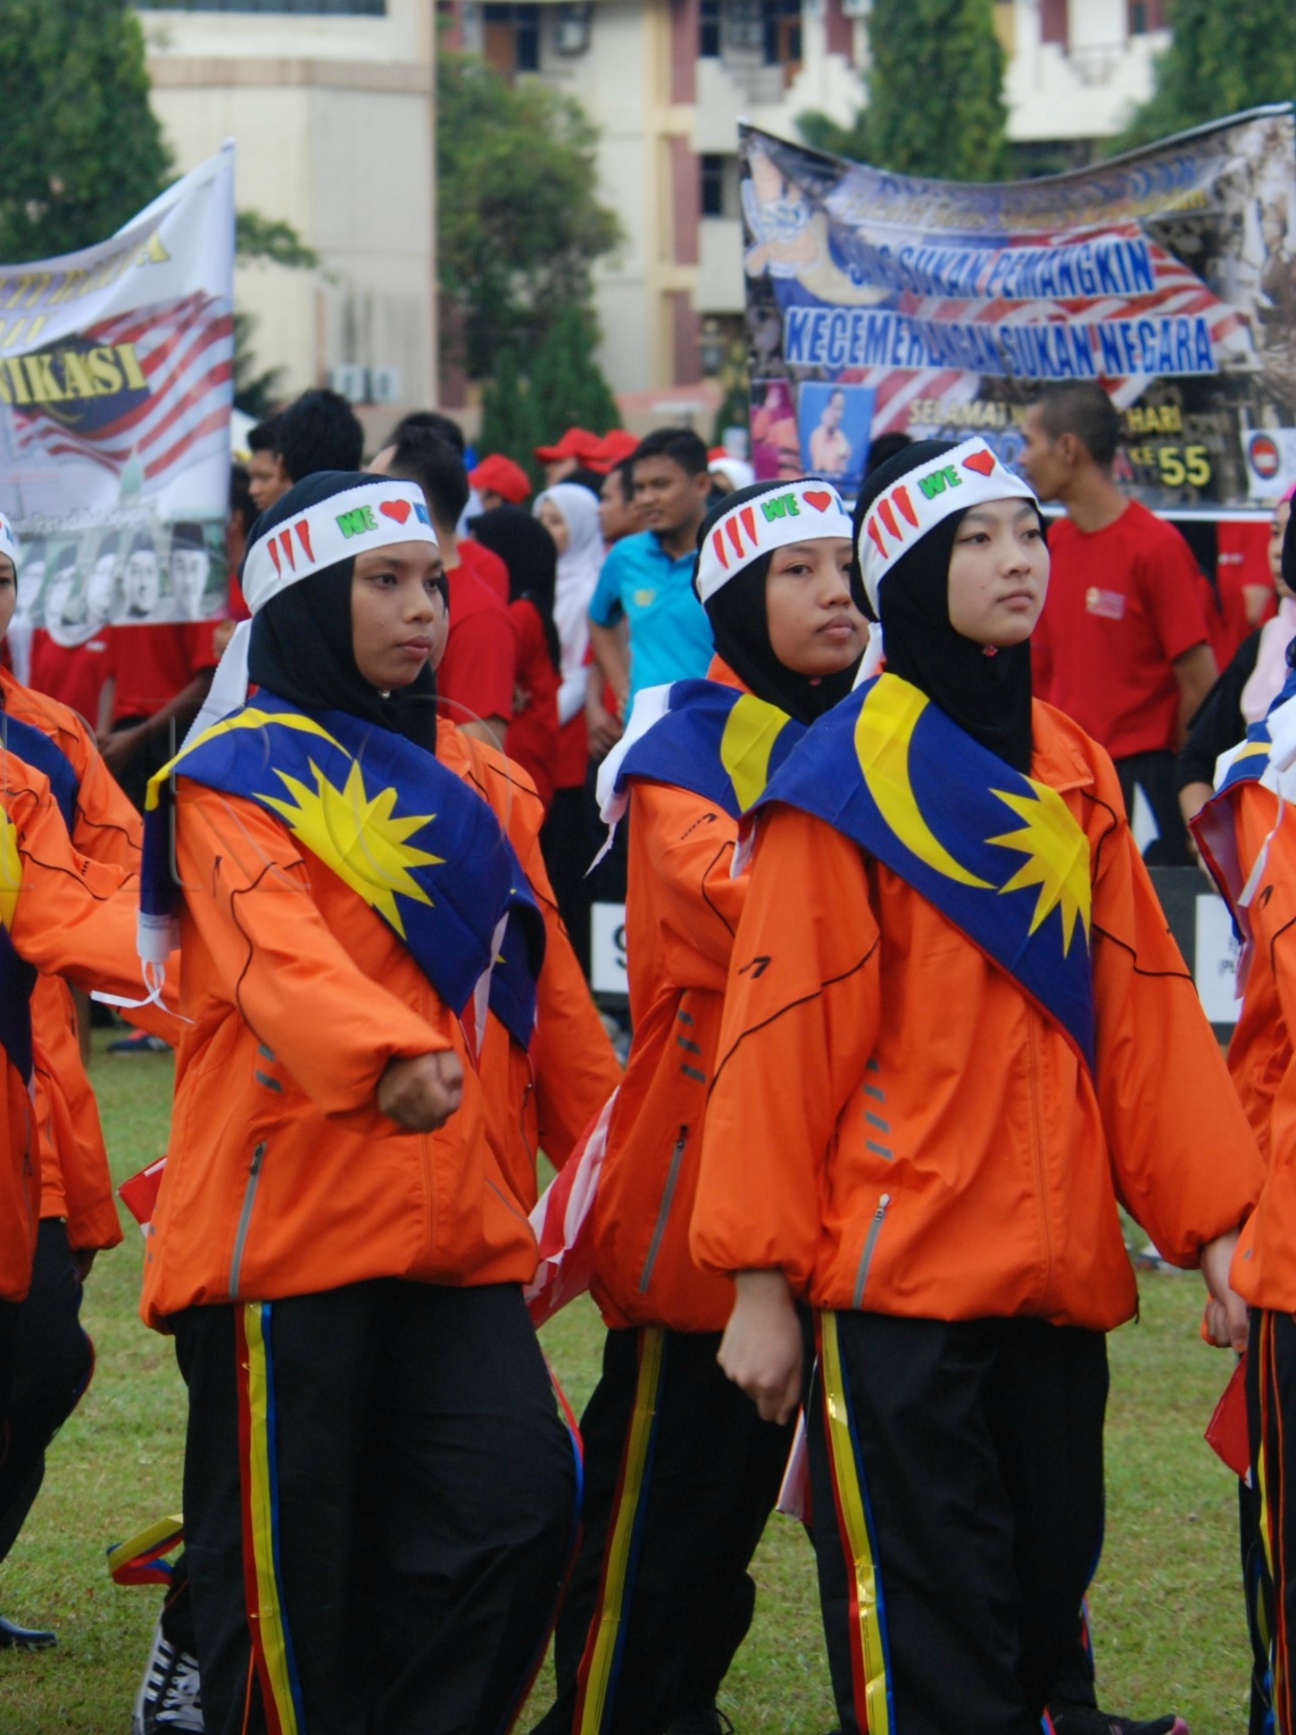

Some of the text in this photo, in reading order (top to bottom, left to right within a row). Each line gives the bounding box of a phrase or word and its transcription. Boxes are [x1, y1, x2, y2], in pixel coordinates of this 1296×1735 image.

[900, 246, 982, 297] SUKAN
[985, 239, 1156, 297] PEMANGKIN
[1002, 323, 1098, 377] SUKAN
[1102, 317, 1215, 375] NEGARA
[1126, 405, 1182, 432] HARI
[917, 465, 963, 500] WE
[1158, 445, 1211, 487] 55
[335, 504, 380, 539] WE
[759, 492, 801, 524] WE
